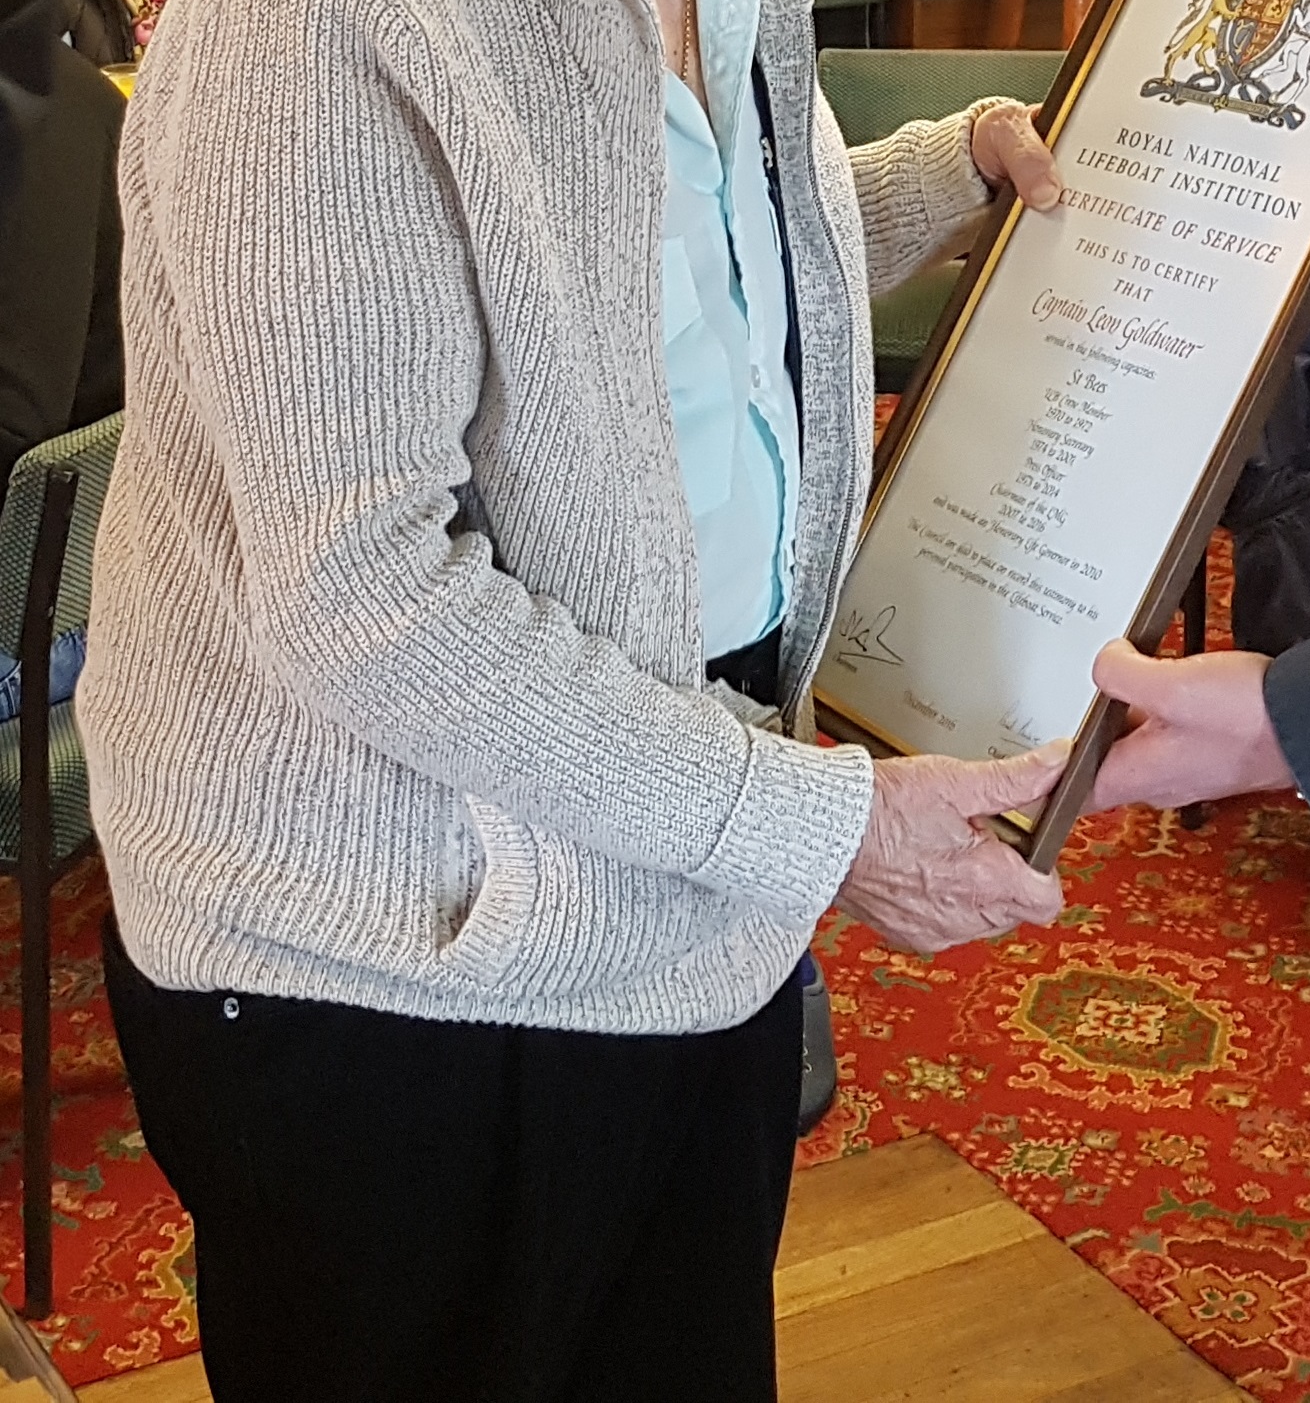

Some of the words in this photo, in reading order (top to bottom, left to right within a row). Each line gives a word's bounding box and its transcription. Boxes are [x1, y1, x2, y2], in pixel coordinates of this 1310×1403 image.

[1116, 127, 1175, 158] ROYAL
[1183, 143, 1283, 184] NATIONAL
[1076, 147, 1165, 185] LIFEBOAT
[1169, 171, 1303, 222] INSTITUTION
[1057, 186, 1167, 232] CERTIFICATE
[1171, 219, 1199, 240] OF
[1201, 228, 1283, 265] SERVICE
[1075, 237, 1110, 260] THIS
[1111, 249, 1129, 266] IS
[1131, 255, 1151, 272] TO
[1154, 262, 1220, 294] CERTIFY
[1112, 278, 1155, 303] THAT
[1030, 287, 1089, 324] Captain
[1115, 316, 1207, 360] Goldwater
[1066, 368, 1084, 386] St
[1084, 373, 1109, 394] Bees
[1063, 414, 1074, 425] to
[1081, 400, 1114, 421] Member
[1024, 419, 1062, 446] Honorary
[1059, 433, 1095, 460] Secretary
[1047, 446, 1057, 457] to
[1040, 463, 1068, 482] Officer
[1032, 481, 1041, 491] to
[1018, 514, 1028, 525] to
[1034, 500, 1048, 515] the
[933, 494, 948, 508] and
[978, 518, 989, 528] an
[985, 519, 1025, 549] Honorary
[1036, 543, 1071, 567] Governor
[1069, 557, 1081, 571] in
[1079, 562, 1104, 581] 2010
[996, 563, 1008, 574] on
[1028, 576, 1045, 593] this
[1042, 586, 1078, 615] testimony
[1077, 603, 1087, 614] to
[996, 582, 1011, 598] the
